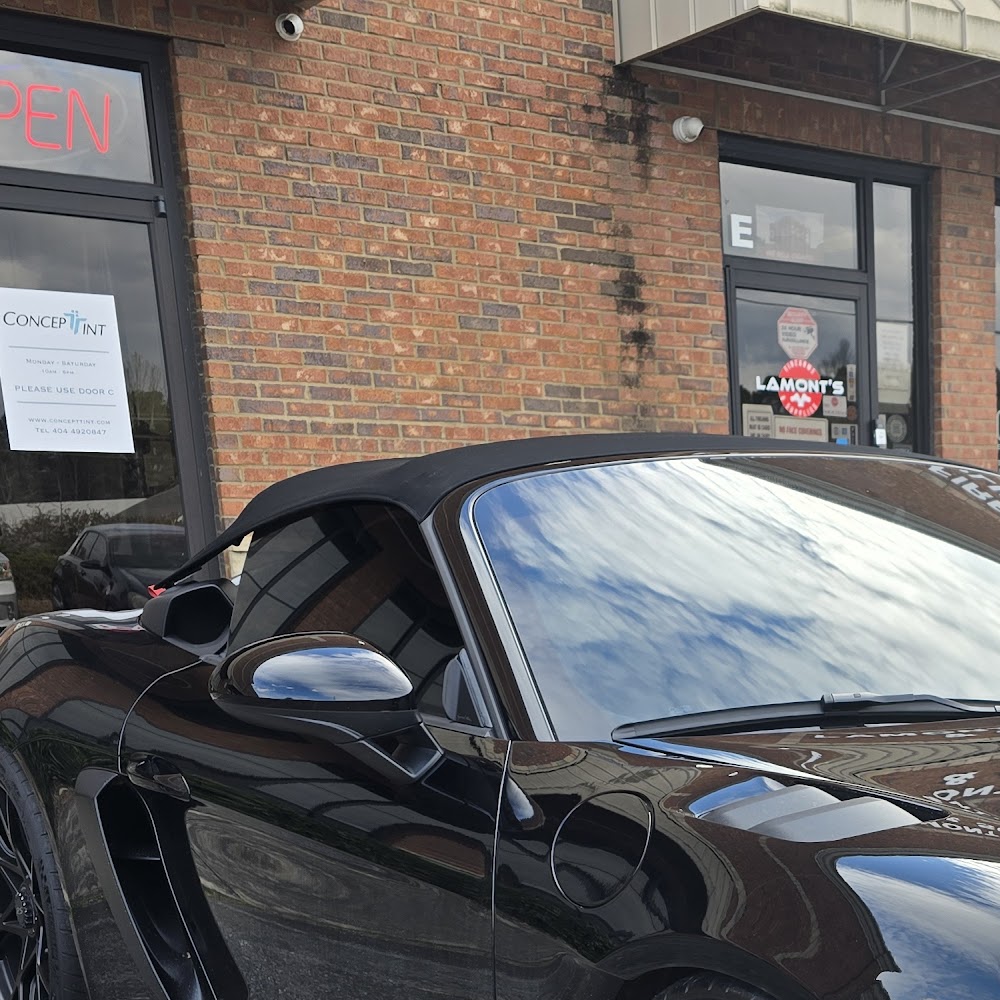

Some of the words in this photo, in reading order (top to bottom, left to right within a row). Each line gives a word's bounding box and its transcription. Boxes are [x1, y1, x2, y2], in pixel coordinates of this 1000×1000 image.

[730, 213, 754, 249] E
[26, 358, 55, 366] MONDAY
[14, 385, 53, 393] PLEASE
[56, 386, 76, 394] USE
[78, 387, 106, 395] DOOR
[755, 375, 845, 395] LAMONT'S
